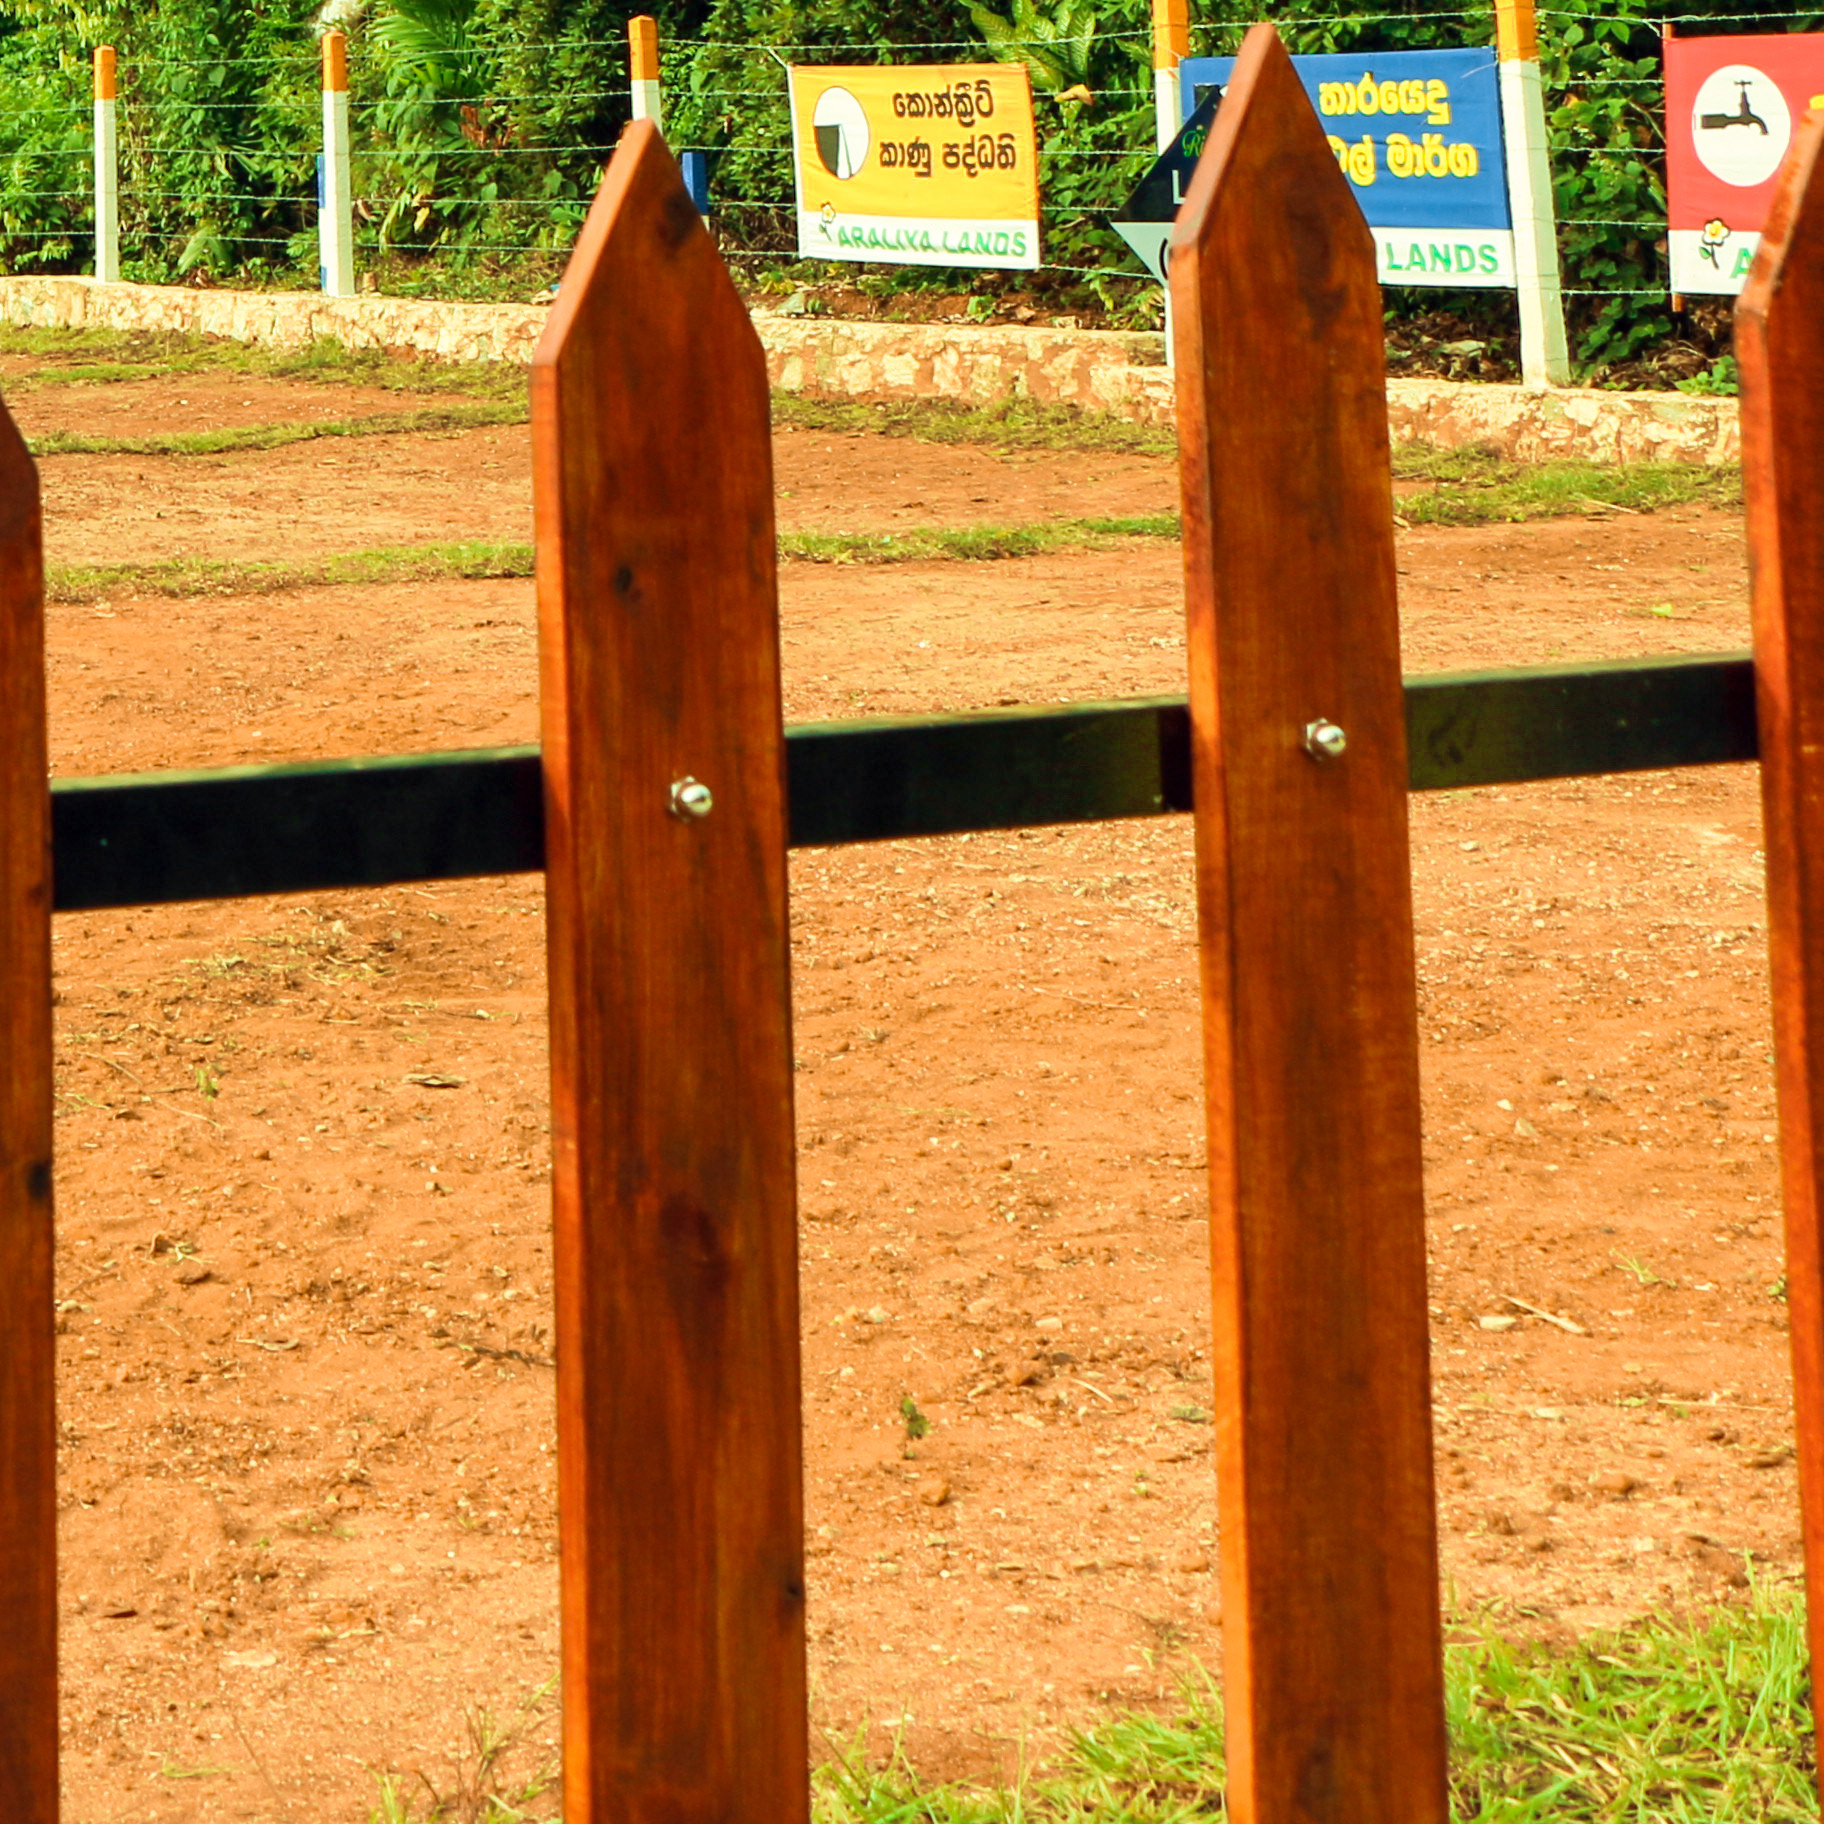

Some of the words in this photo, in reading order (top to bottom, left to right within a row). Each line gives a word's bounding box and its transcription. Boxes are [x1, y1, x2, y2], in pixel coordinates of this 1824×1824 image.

[837, 225, 938, 253] ARALIYA
[941, 230, 1027, 257] LANDS
[1385, 242, 1499, 274] LANDS
